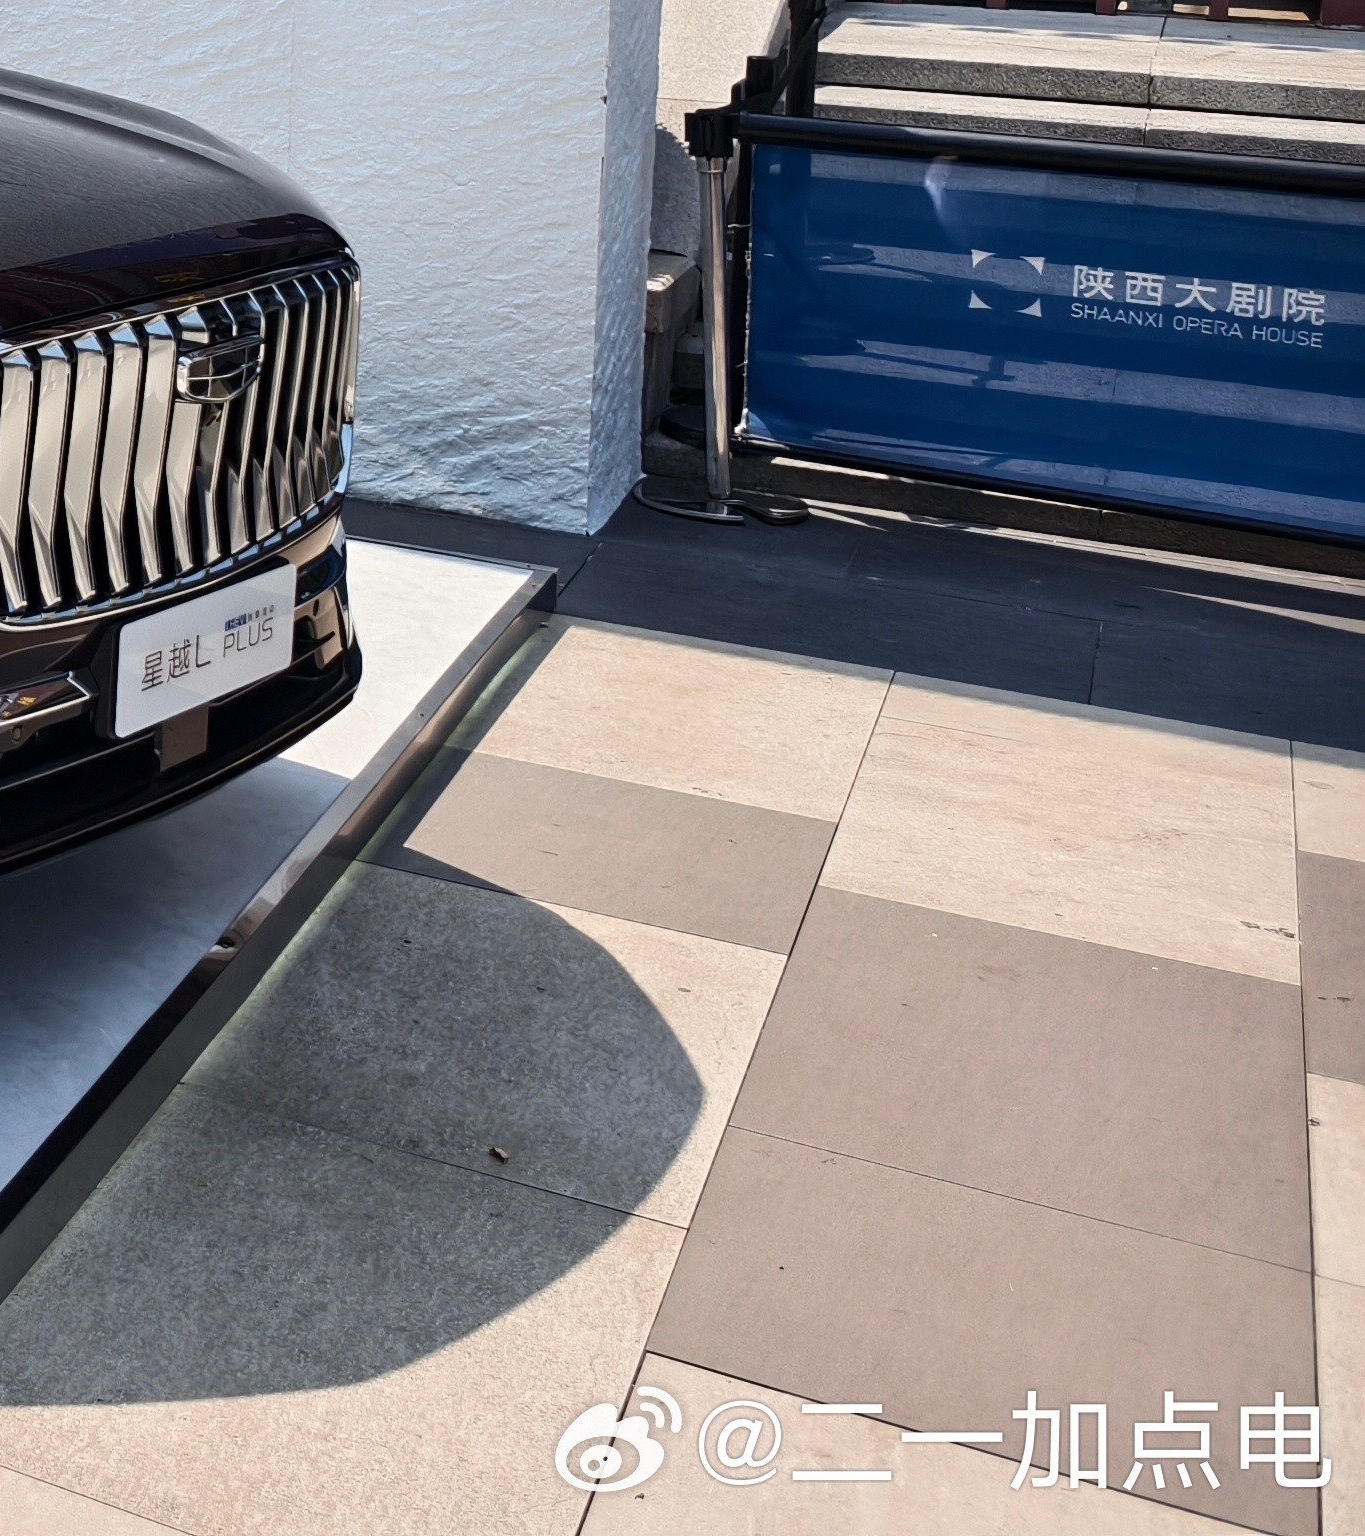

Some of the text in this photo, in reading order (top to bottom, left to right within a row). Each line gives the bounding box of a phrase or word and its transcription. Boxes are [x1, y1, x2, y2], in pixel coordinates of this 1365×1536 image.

[1070, 302, 1324, 349] SHAANXI OPERA HOUSE
[1071, 264, 1327, 327] 陕西大剧院
[141, 616, 274, 692] 星越L PLUS
